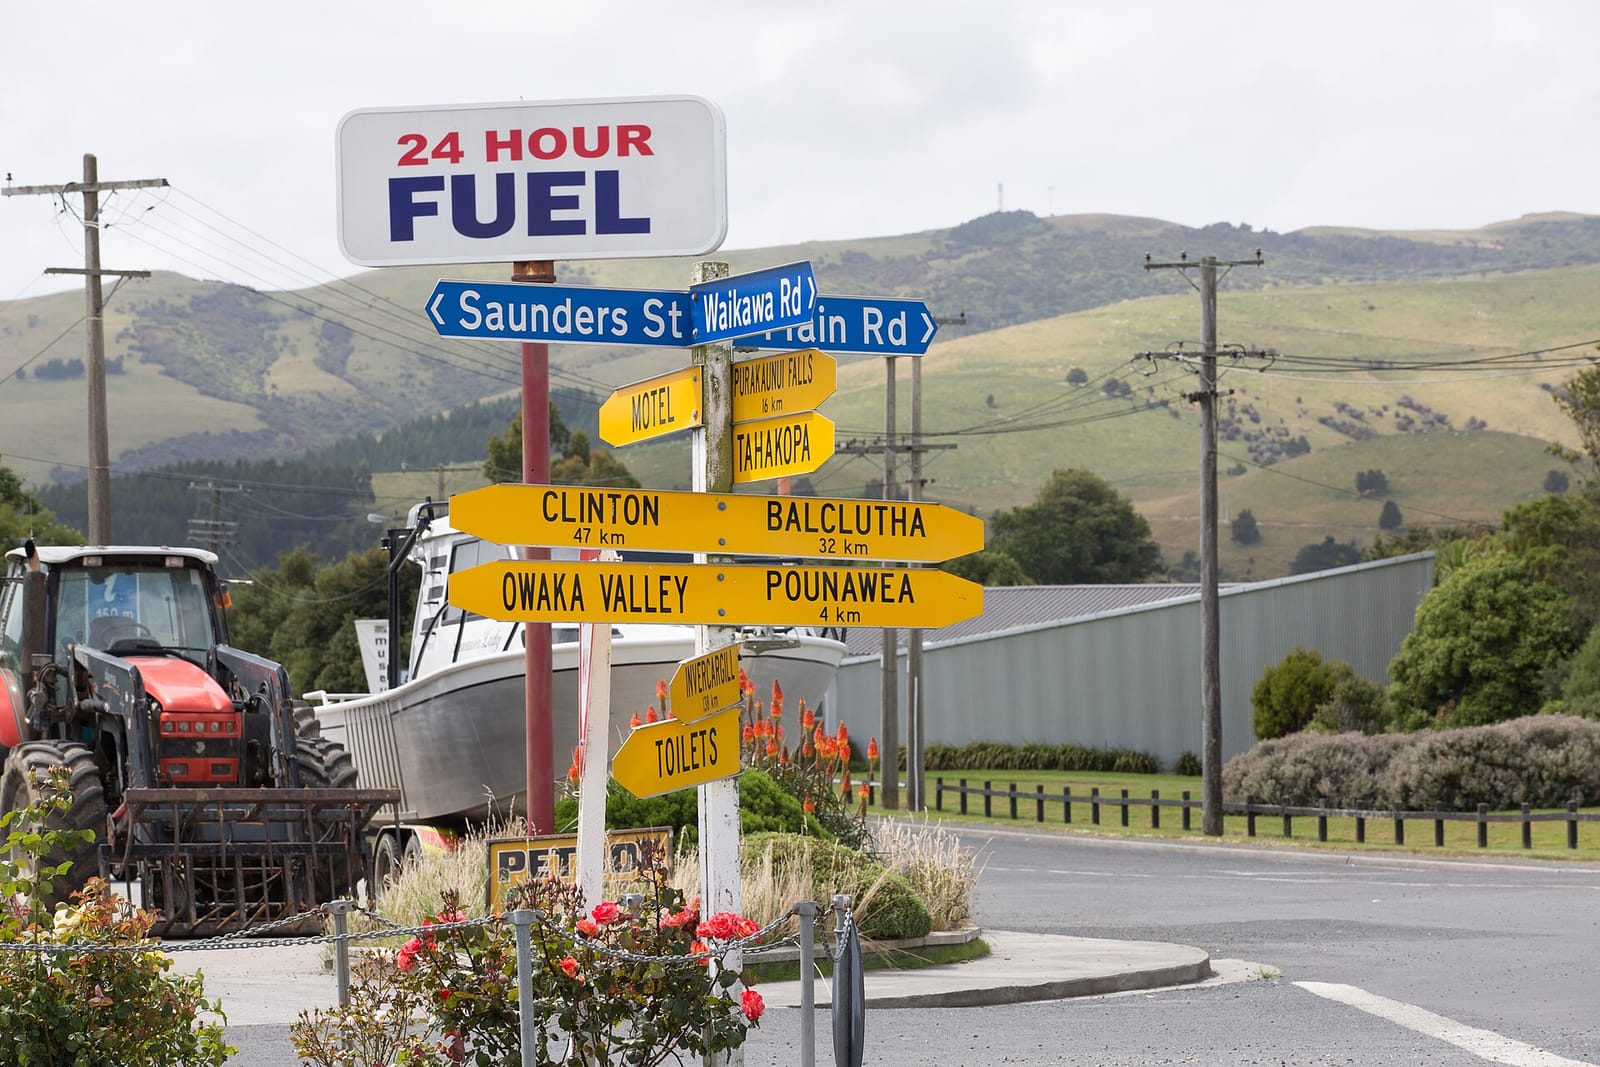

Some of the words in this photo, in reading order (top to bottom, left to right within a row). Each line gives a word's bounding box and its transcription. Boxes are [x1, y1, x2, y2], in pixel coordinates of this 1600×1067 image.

[397, 131, 464, 166] 24
[485, 124, 654, 162] HOUR
[388, 169, 651, 242] FUEL
[459, 290, 628, 337] Saunders
[642, 298, 682, 338] St
[703, 289, 774, 333] Waikawa
[780, 275, 802, 319] Rd
[765, 305, 847, 344] ain
[862, 307, 907, 346] Rd
[734, 359, 785, 397] PURAKAUNUI
[788, 353, 813, 387] FALLS
[631, 386, 675, 433] MOTEL
[762, 398, 769, 414] 16
[771, 396, 783, 412] km
[736, 423, 811, 473] TAHAKOPA
[543, 490, 659, 526] CLINTON
[767, 500, 926, 538] BALCLUTHA
[573, 528, 591, 544] 47
[600, 528, 625, 545] km
[819, 538, 836, 554] 32
[844, 539, 868, 555] km
[502, 571, 585, 612] OWAKA
[599, 574, 689, 614] VALLEY
[767, 570, 915, 604] POUNAWEA
[819, 606, 829, 622] 4
[836, 606, 861, 623] km
[684, 649, 736, 699] INVERCARGILL
[655, 727, 718, 778] TOILETS
[498, 841, 662, 882] PETO
